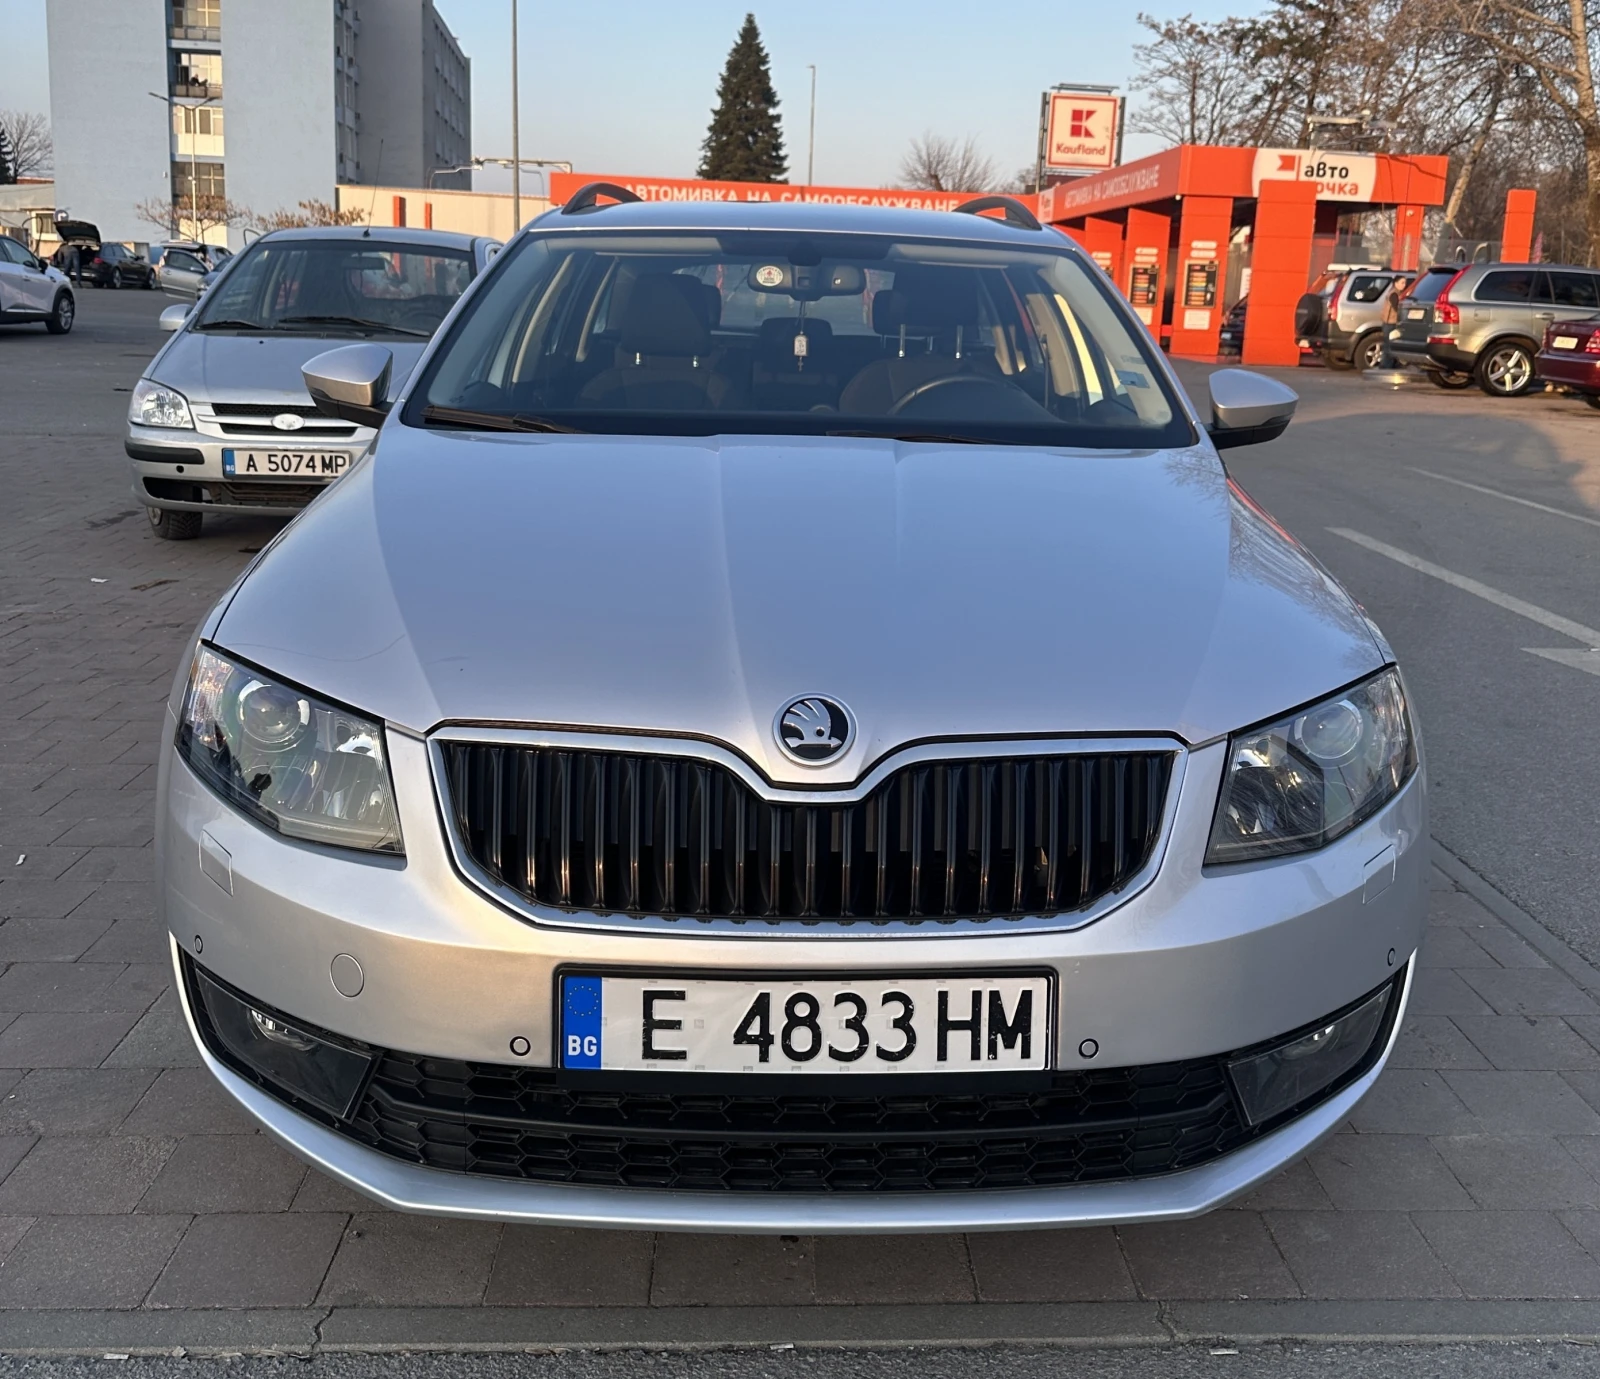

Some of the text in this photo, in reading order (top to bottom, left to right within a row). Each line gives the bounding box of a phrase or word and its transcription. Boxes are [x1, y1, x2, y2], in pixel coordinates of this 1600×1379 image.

[1056, 142, 1107, 156] Kaufland
[1304, 161, 1349, 179] авто
[747, 190, 772, 202] НА
[1316, 181, 1359, 196] очка
[246, 453, 347, 473] A 5074 MP
[642, 988, 1034, 1063] E 4833 HM
[567, 1035, 598, 1057] BG
